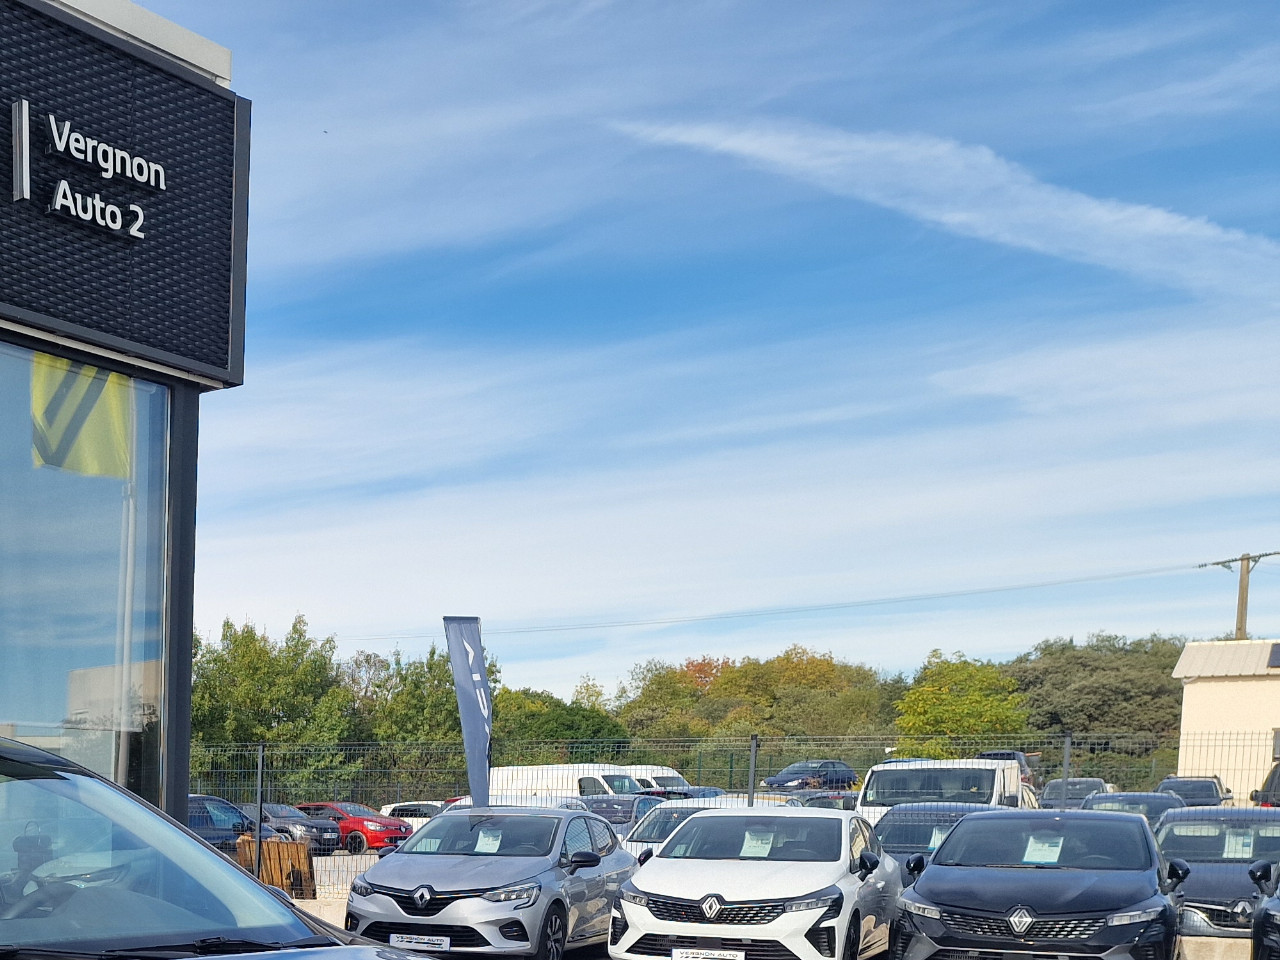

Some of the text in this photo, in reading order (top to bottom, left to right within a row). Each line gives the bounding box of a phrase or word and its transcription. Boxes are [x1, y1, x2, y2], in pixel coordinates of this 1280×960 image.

[47, 113, 167, 191] Vergnon
[53, 179, 145, 239] Auto 2
